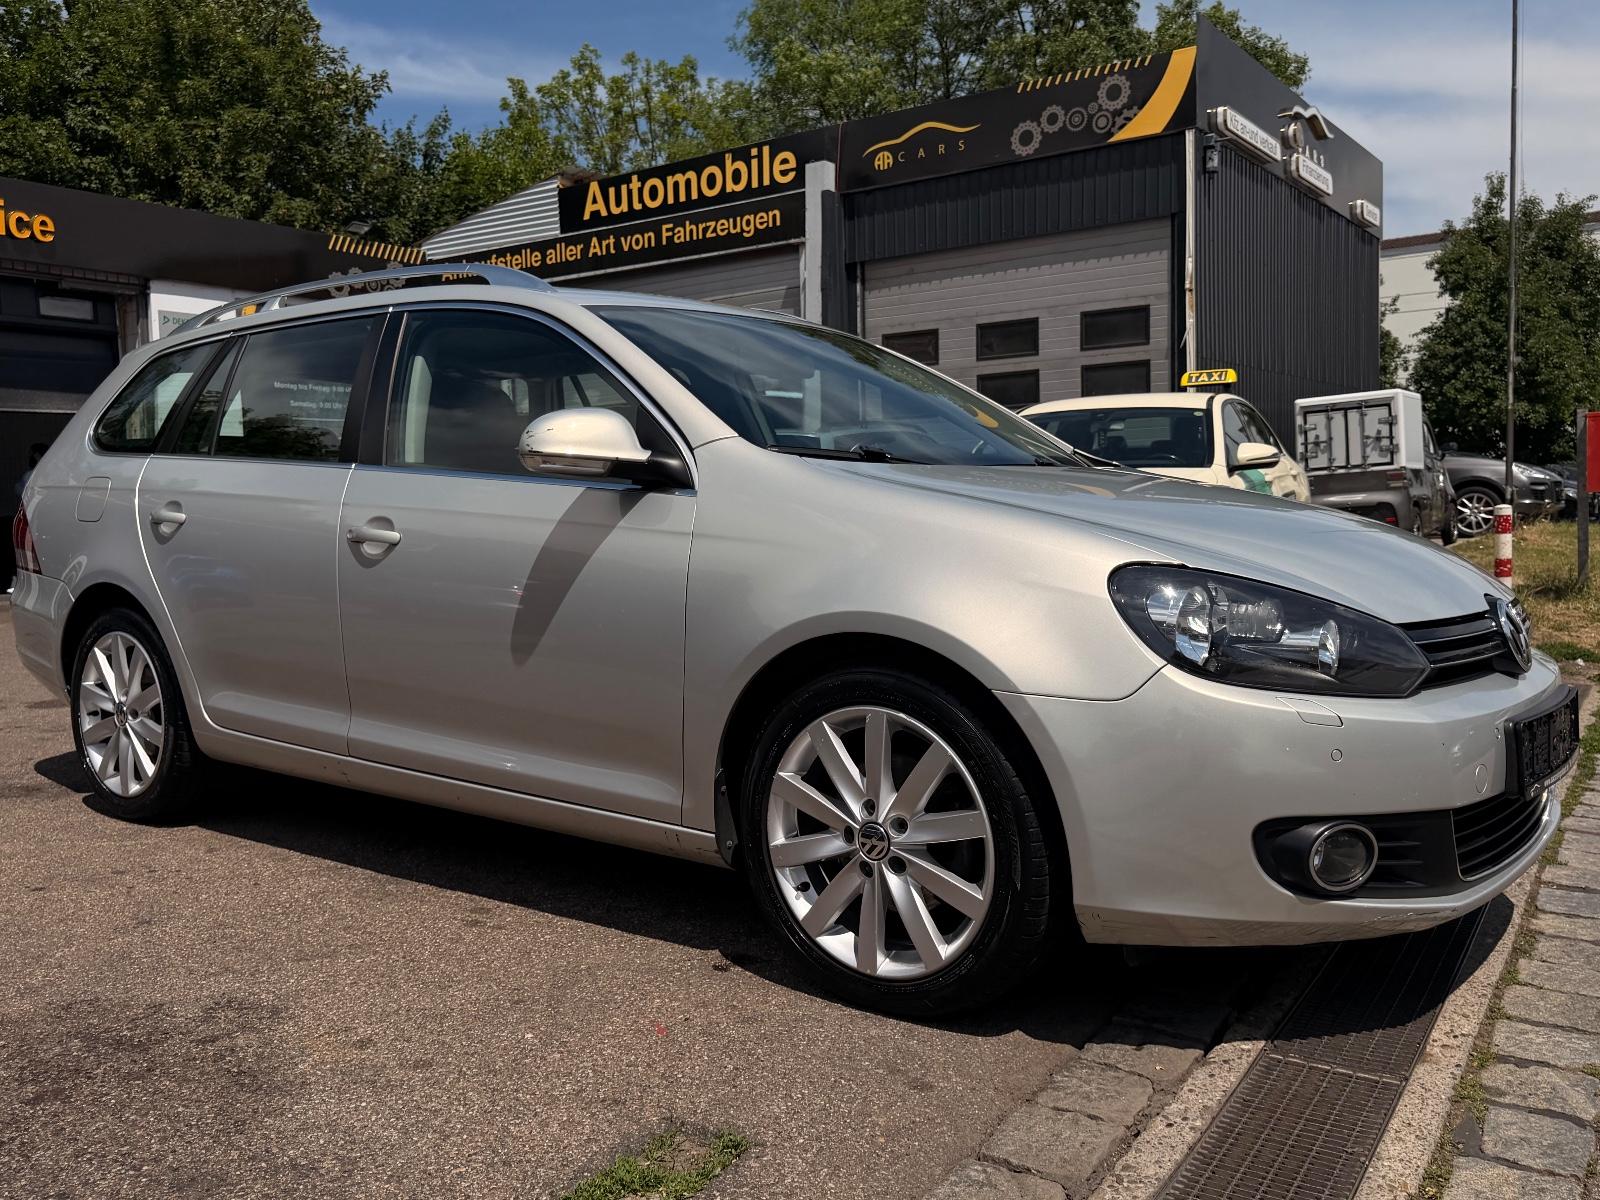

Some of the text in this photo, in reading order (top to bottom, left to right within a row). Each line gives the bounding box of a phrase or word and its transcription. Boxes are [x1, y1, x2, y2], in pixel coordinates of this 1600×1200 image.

[583, 146, 797, 220] Automobile
[441, 209, 781, 282] Anfstelle aller Art von Fahrzeugen
[1190, 371, 1226, 383] TAXI
